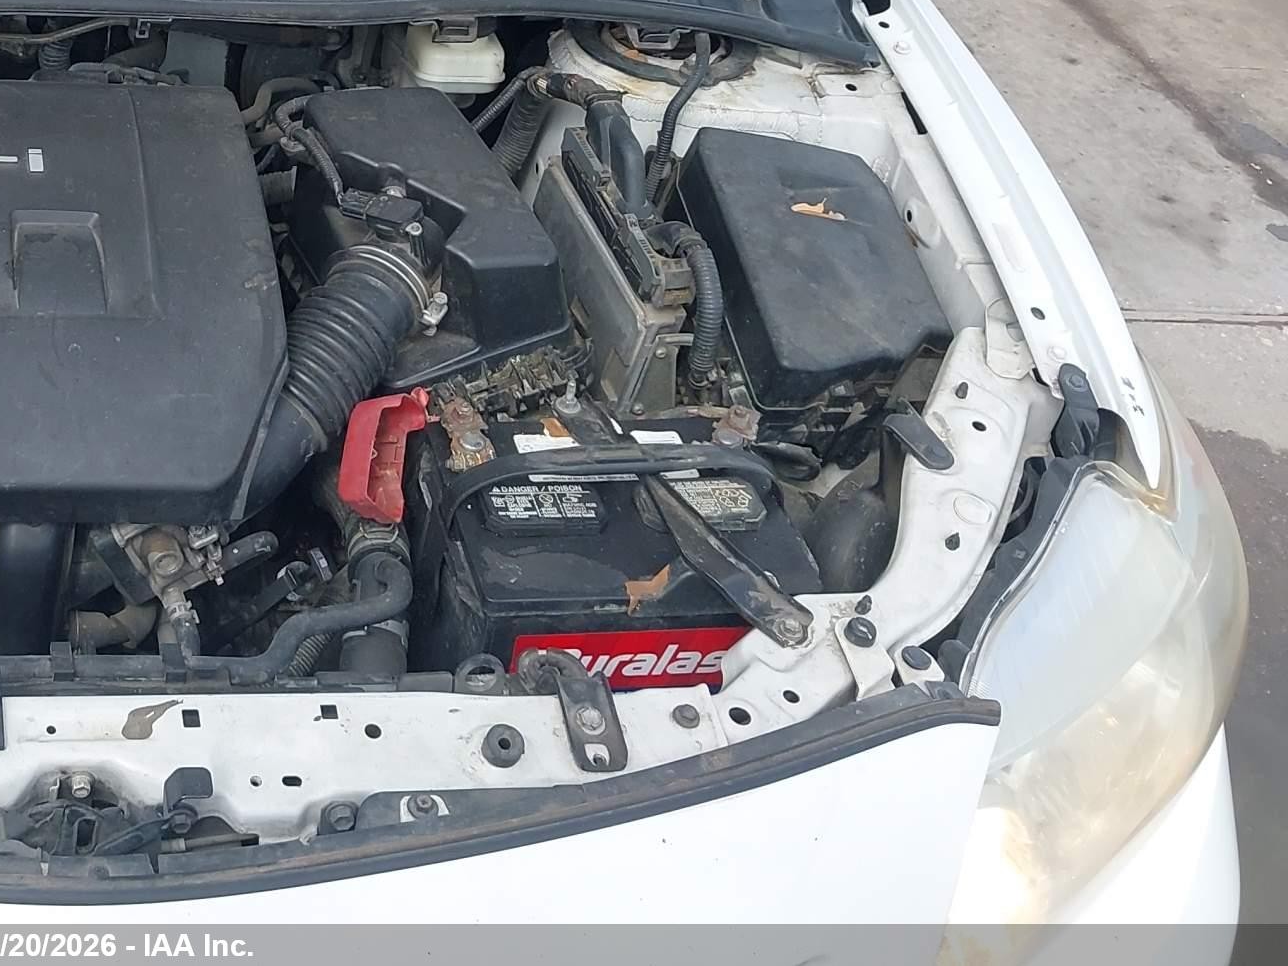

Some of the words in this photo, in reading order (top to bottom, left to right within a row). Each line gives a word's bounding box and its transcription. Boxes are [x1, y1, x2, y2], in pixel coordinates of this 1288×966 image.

[501, 485, 539, 493] DANGER
[547, 484, 583, 492] POISON
[538, 642, 729, 678] uralas
